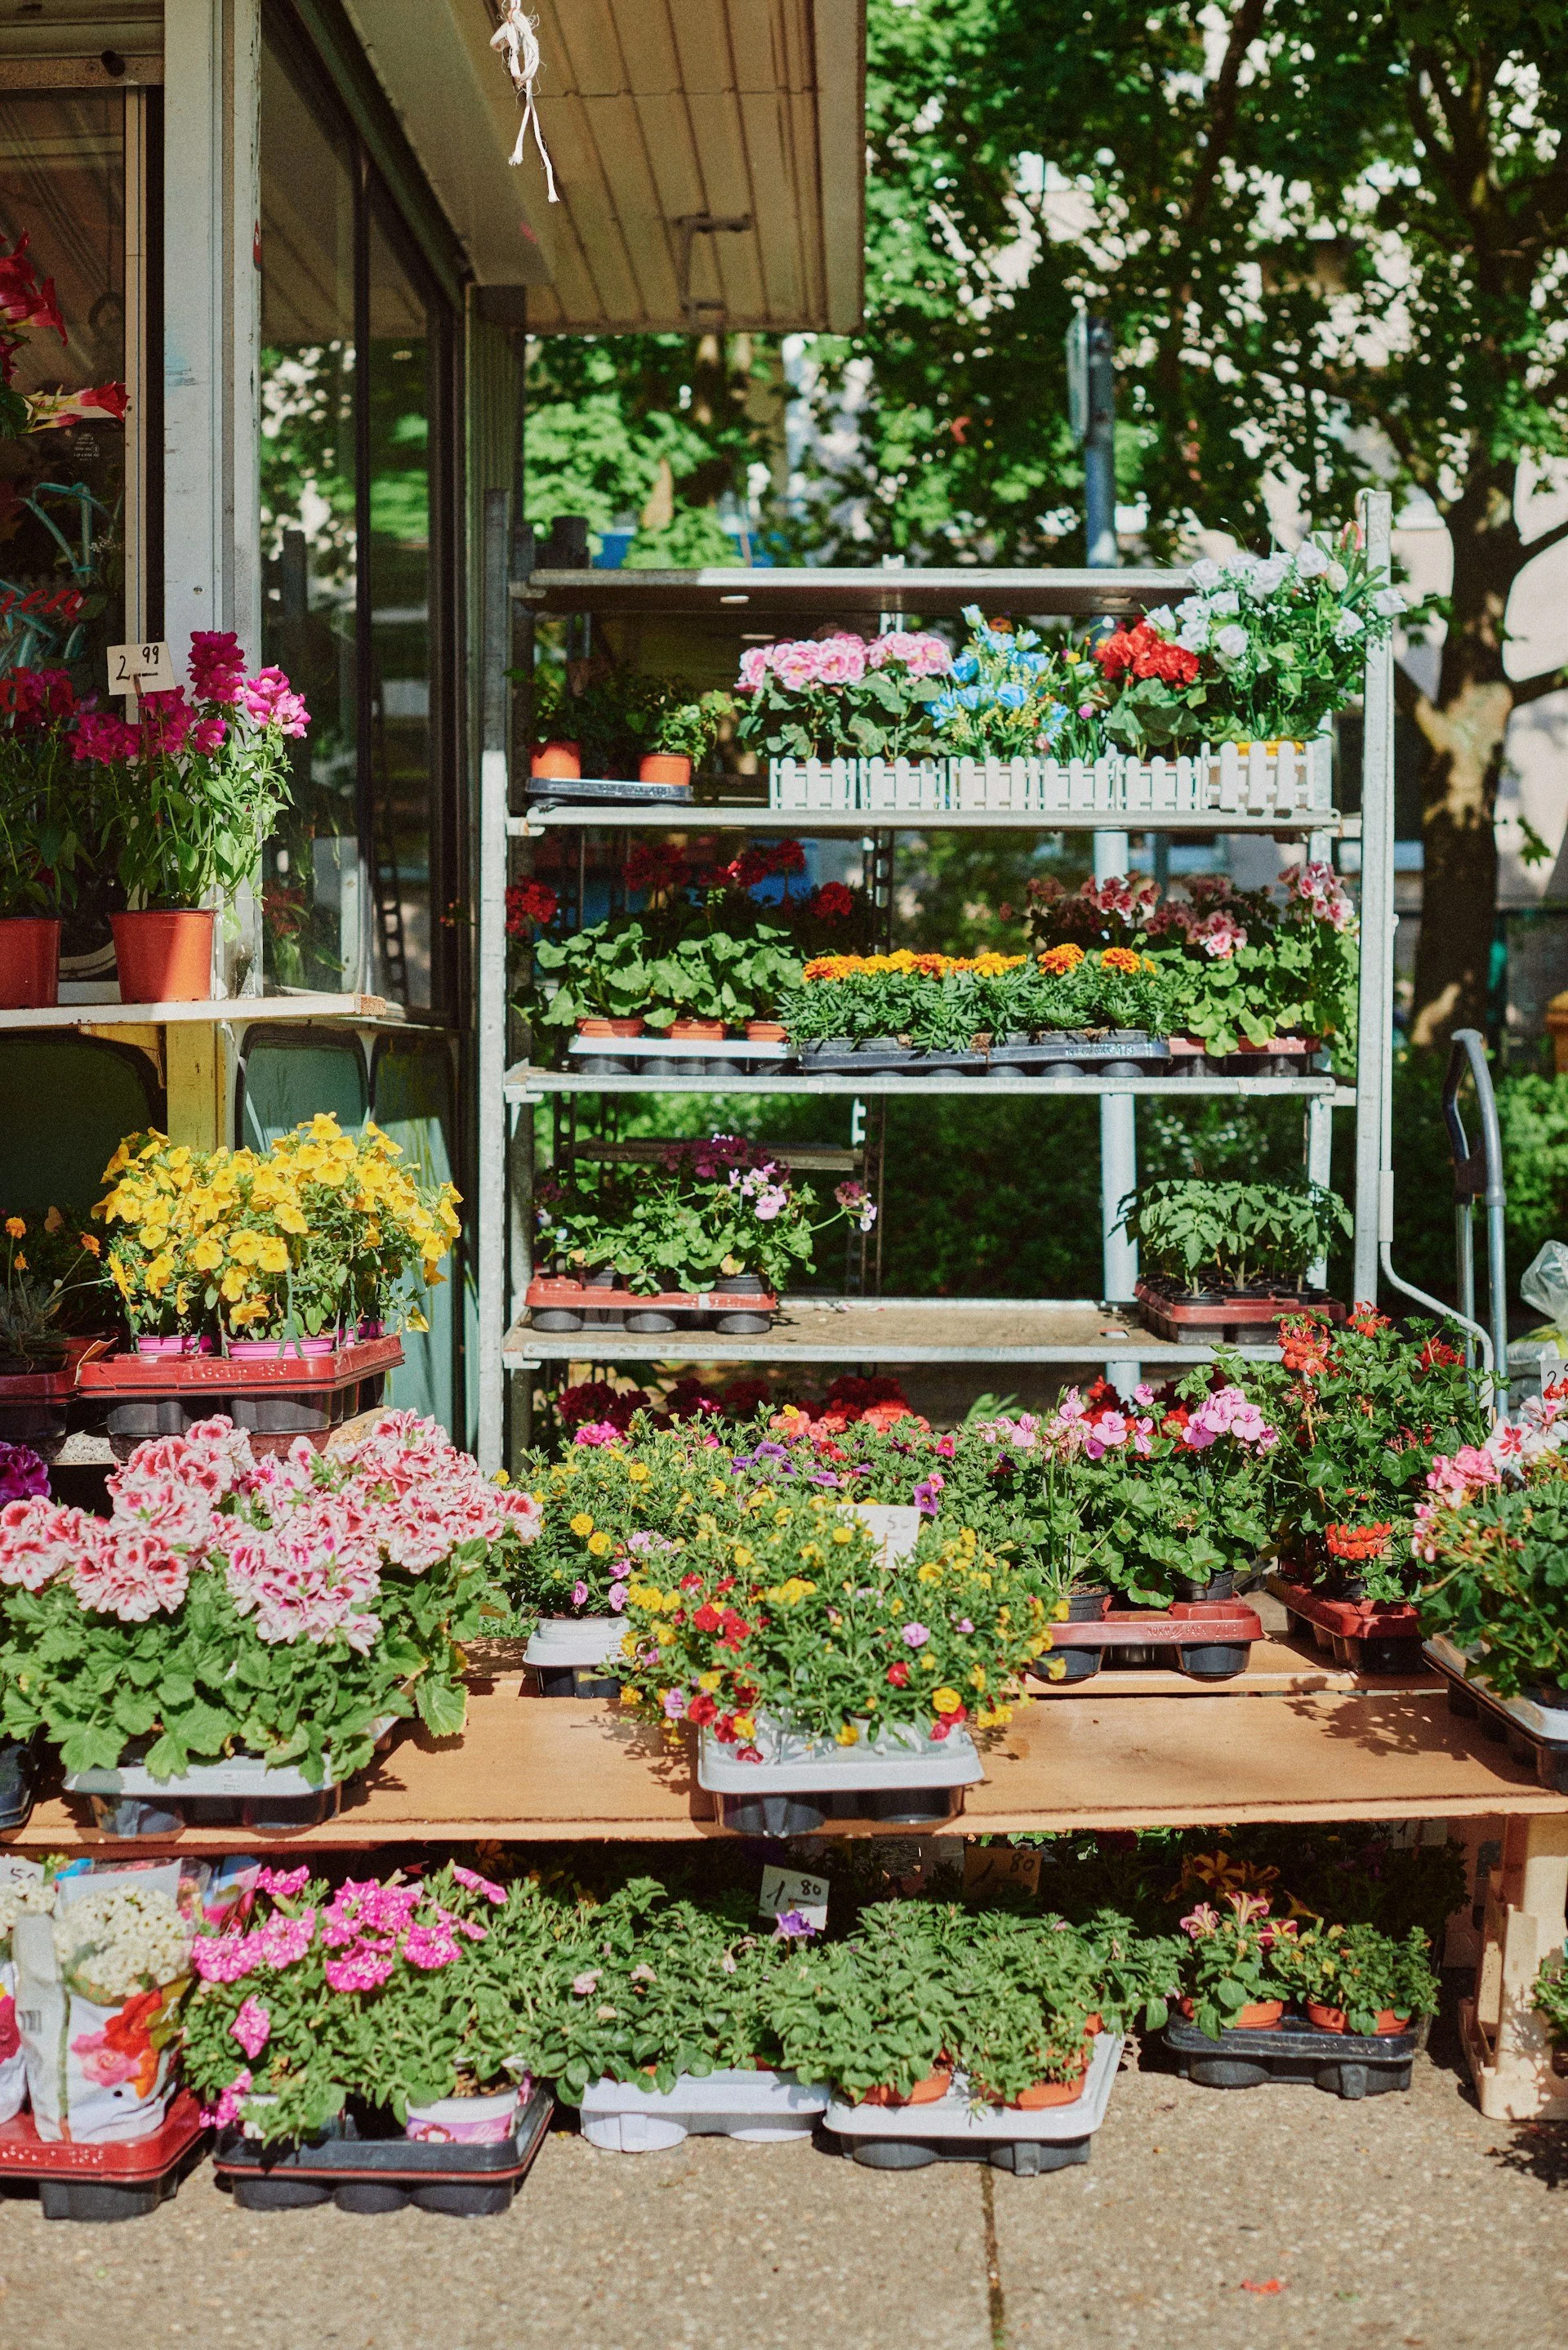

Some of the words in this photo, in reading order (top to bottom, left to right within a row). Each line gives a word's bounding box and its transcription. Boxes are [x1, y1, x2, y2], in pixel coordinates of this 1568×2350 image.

[116, 655, 131, 680] 2
[142, 645, 159, 664] 99
[1009, 1851, 1036, 1873] 80
[766, 1880, 785, 1906] 1
[801, 1880, 822, 1896] 80
